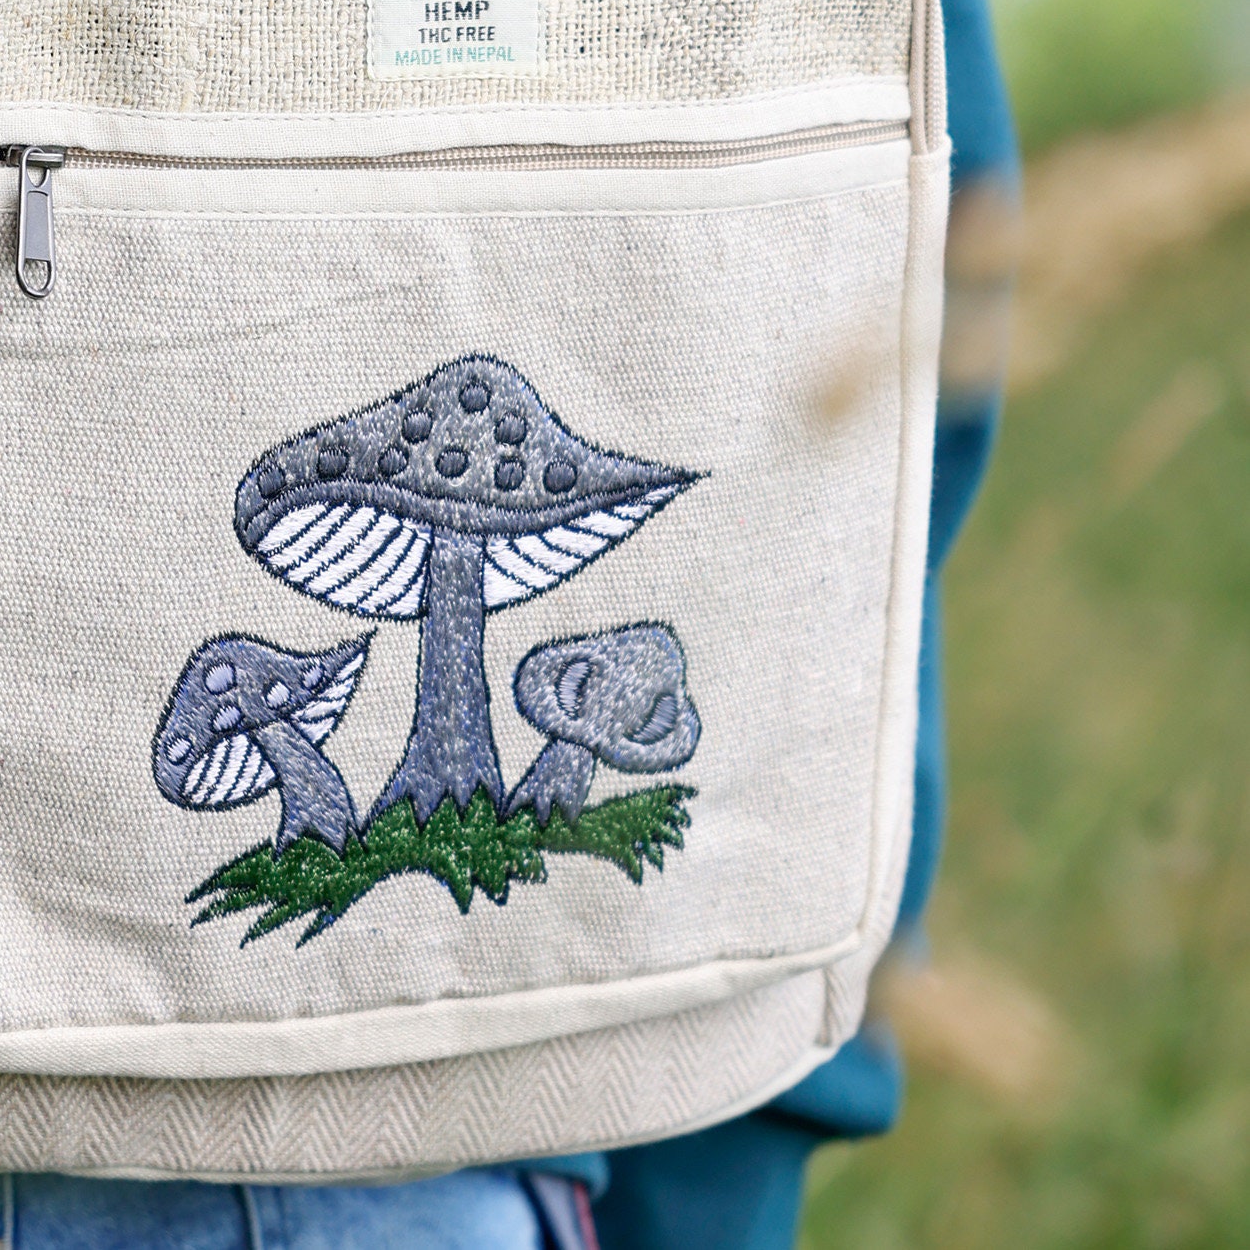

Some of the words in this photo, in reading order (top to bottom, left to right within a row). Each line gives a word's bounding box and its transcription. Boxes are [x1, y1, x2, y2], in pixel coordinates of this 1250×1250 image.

[425, 0, 490, 22] HEMP
[418, 27, 451, 44] THC
[456, 26, 496, 42] FREE
[395, 49, 442, 66] MADE
[446, 48, 463, 63] IN
[466, 46, 516, 63] NEPAL
